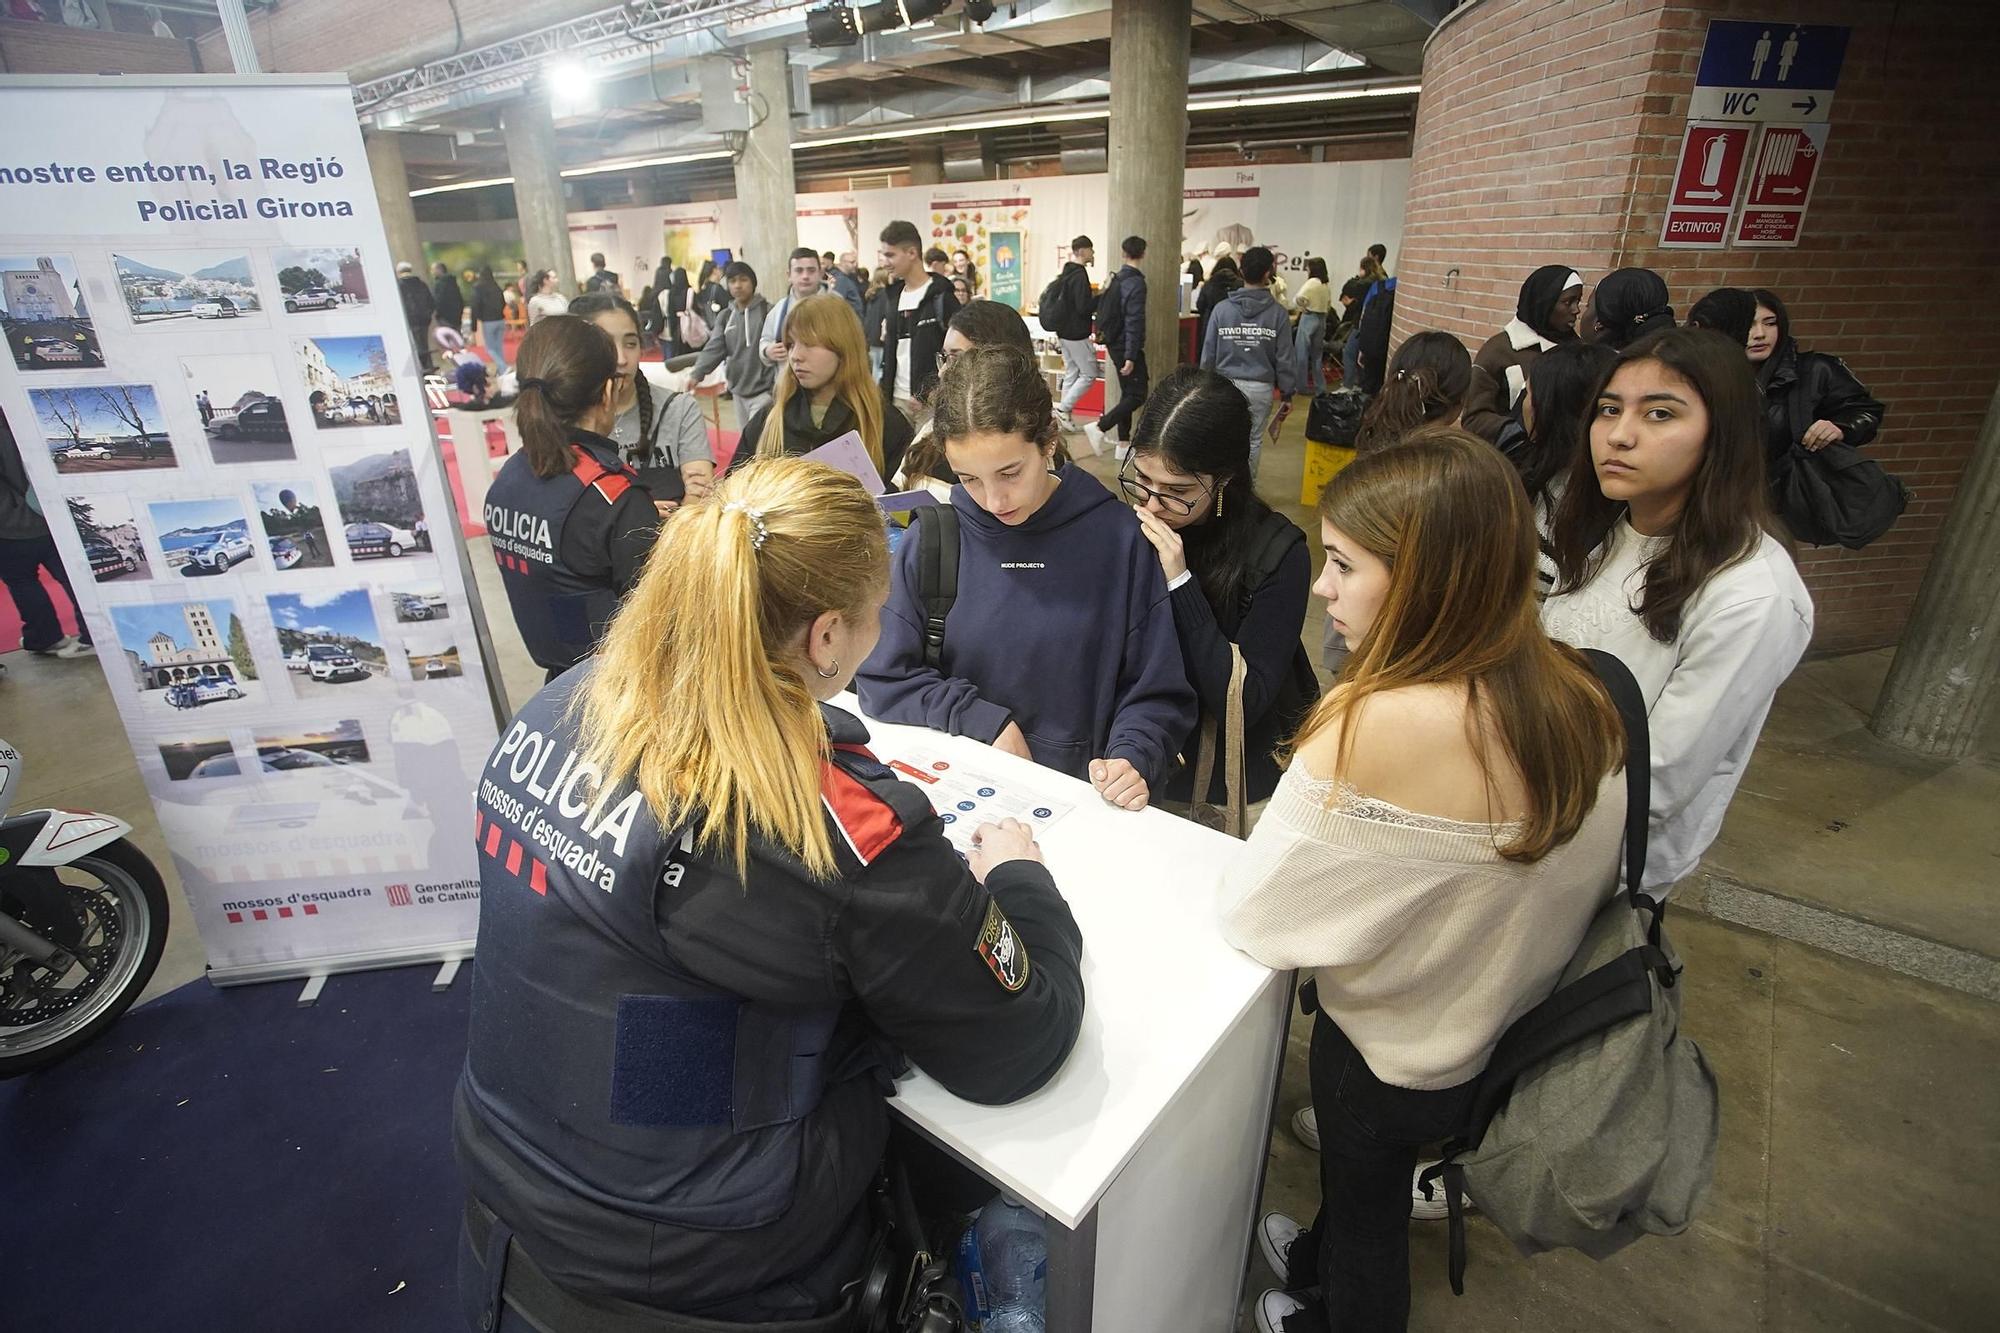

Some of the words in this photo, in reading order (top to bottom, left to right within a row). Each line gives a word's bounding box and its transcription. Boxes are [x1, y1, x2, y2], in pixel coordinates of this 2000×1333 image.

[1722, 92, 1759, 116] WC
[0, 161, 96, 184] nostre
[106, 161, 217, 186] entorn,
[223, 159, 252, 181] la
[259, 157, 344, 184] Regió
[137, 198, 249, 222] Policial
[256, 198, 354, 219] Girona
[1670, 221, 1721, 233] EXTINTOR
[1242, 327, 1277, 338] RECORDS
[484, 503, 552, 549] POLICIA
[491, 719, 644, 858] POLICIA
[480, 777, 523, 825] mossos
[222, 897, 284, 911] mossos
[287, 886, 372, 904] d'esquadra
[415, 879, 480, 894] Generalita
[418, 895, 434, 905] de
[438, 891, 480, 903] Catalu
